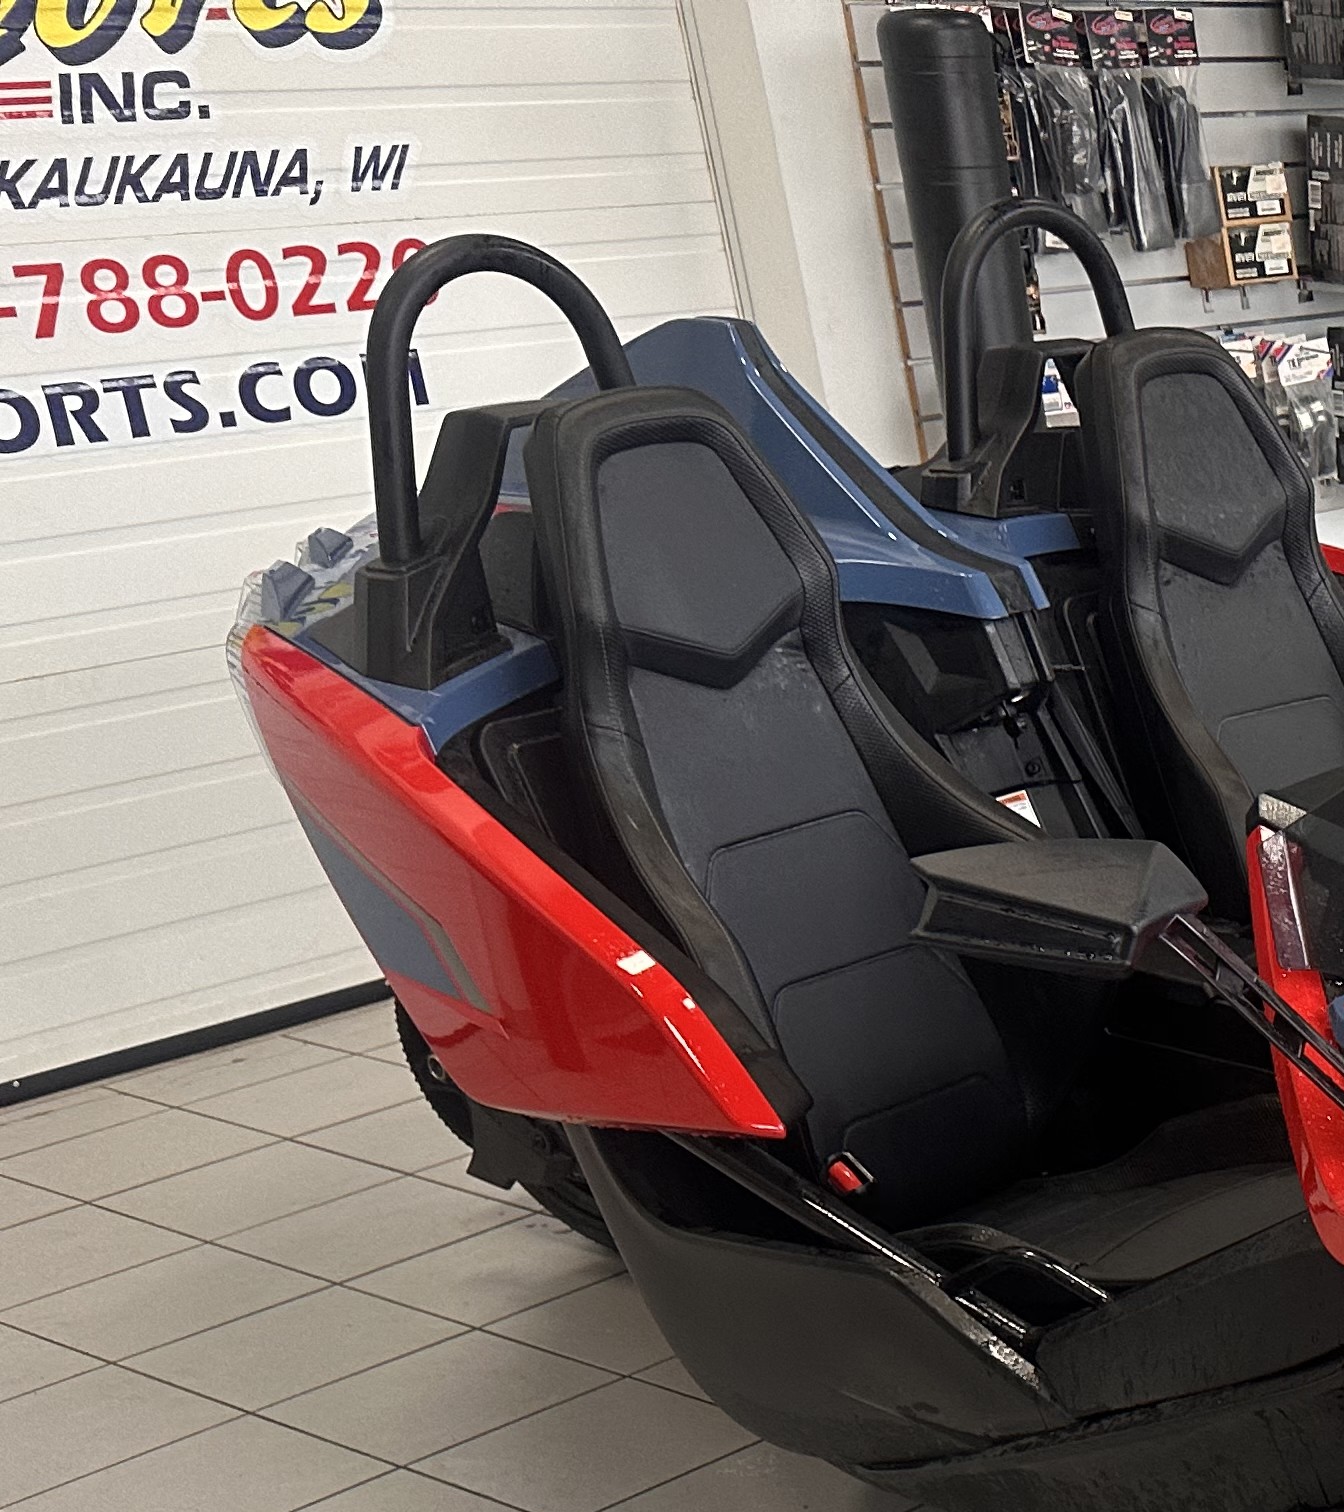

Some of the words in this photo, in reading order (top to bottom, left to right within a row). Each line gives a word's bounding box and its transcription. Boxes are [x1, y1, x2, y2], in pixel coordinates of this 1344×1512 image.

[58, 69, 211, 125] INC.
[0, 148, 325, 210] KAUKAUNA,
[350, 144, 410, 193] WI
[0, 237, 439, 340] -788-022
[0, 348, 430, 455] ORTS.CO
